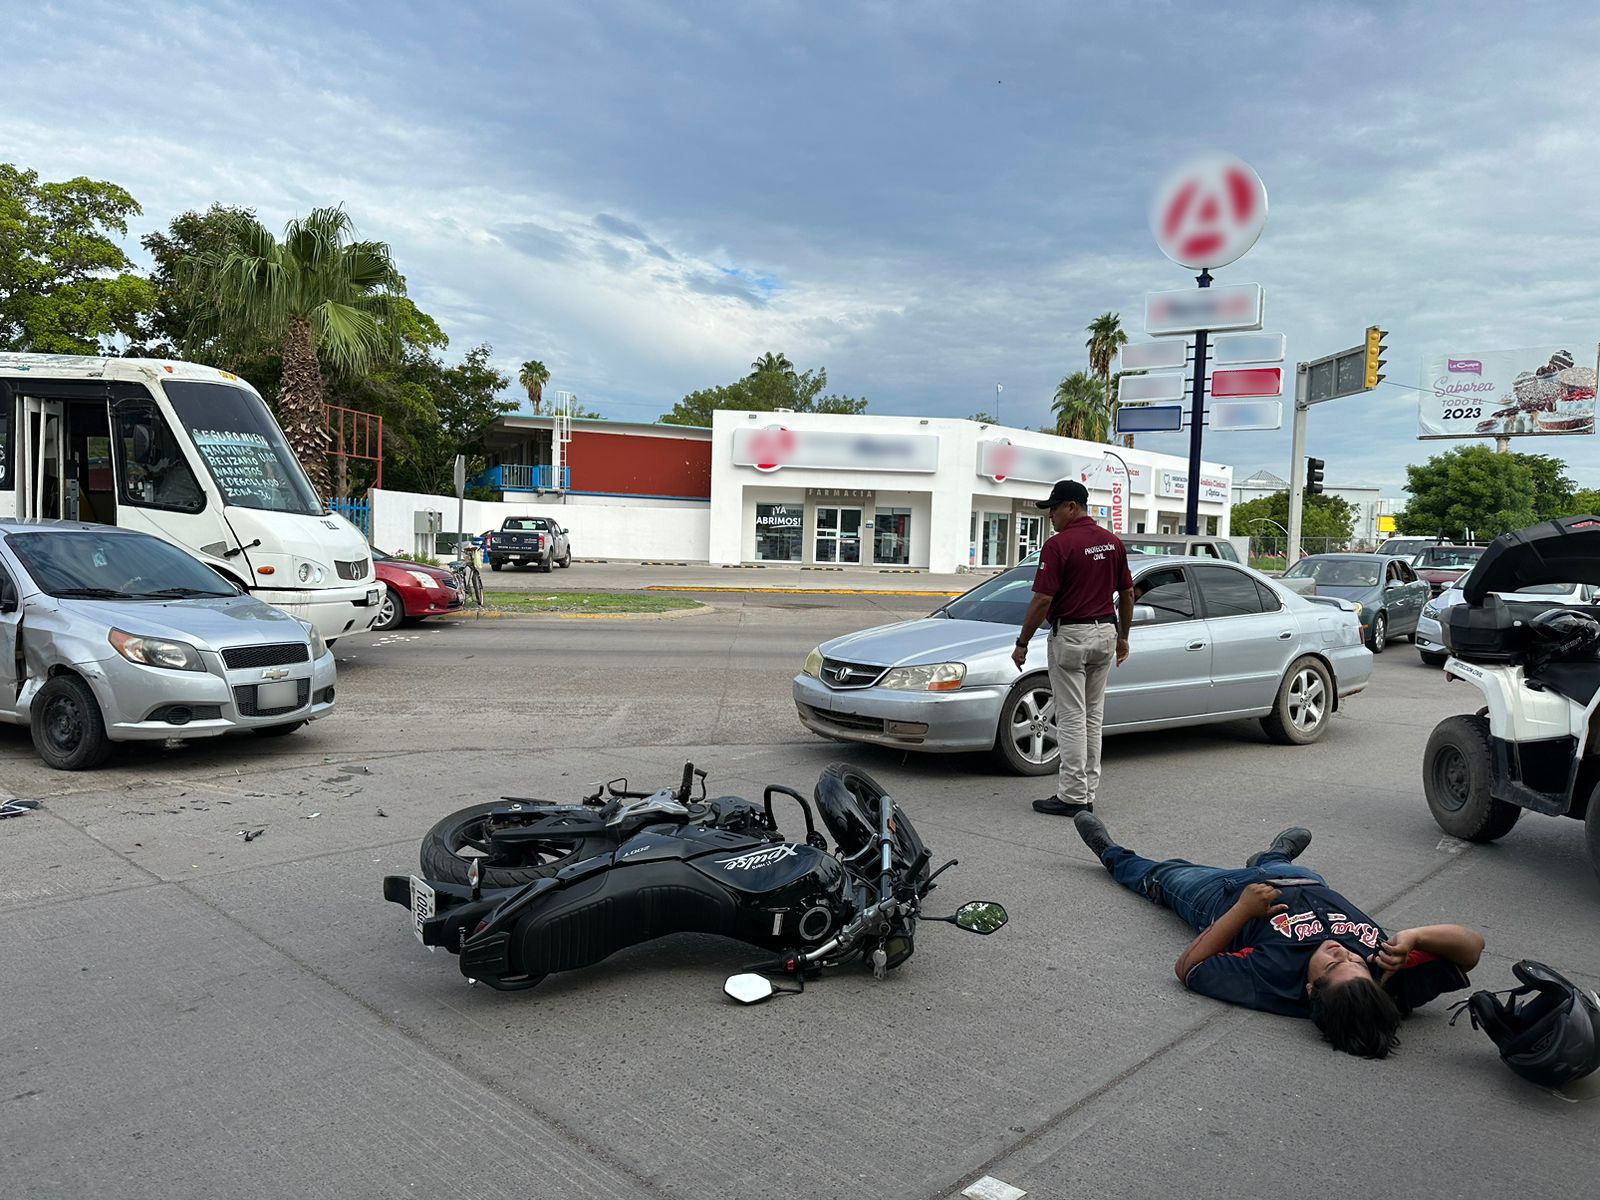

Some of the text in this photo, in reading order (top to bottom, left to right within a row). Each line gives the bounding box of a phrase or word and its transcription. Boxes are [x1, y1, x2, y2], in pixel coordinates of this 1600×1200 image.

[1433, 376, 1495, 397] Saborea
[1442, 399, 1470, 407] TODO
[1442, 407, 1482, 420] 2023
[192, 428, 239, 442] SEGURO
[200, 444, 255, 457] MALVINAS
[207, 456, 259, 466] BELIZARIO
[213, 466, 263, 478] NARANJOS
[226, 477, 280, 488] DEGOLLADO
[808, 489, 873, 498] FARMACIA
[772, 506, 787, 516] ¡YA
[756, 516, 801, 526] ABRIMOS!
[1084, 542, 1116, 556] PROTECCIÓN
[714, 843, 798, 871] Xpulse
